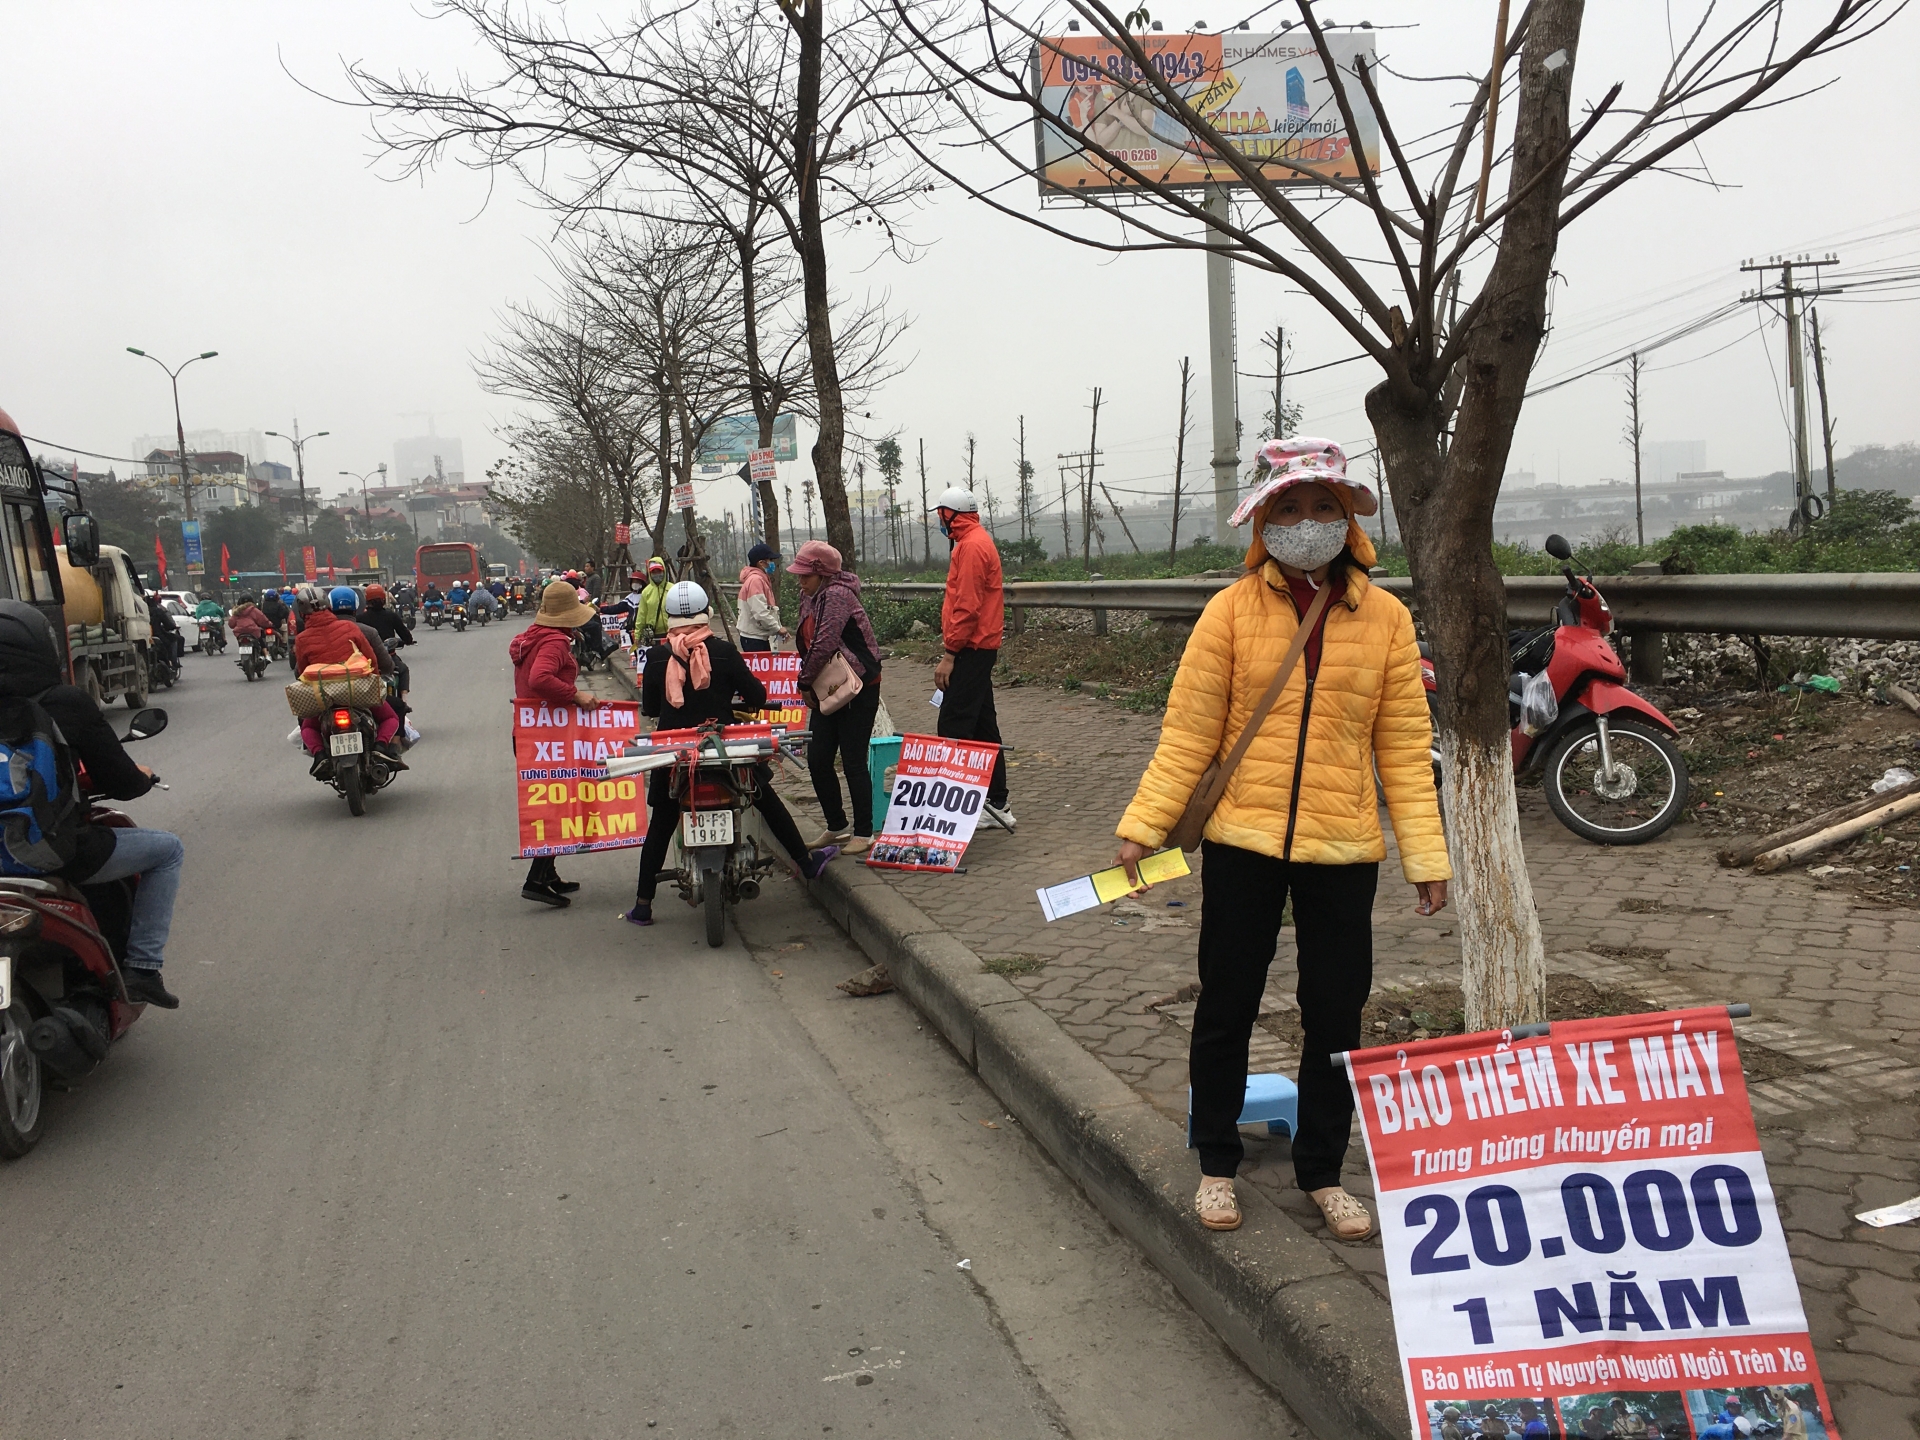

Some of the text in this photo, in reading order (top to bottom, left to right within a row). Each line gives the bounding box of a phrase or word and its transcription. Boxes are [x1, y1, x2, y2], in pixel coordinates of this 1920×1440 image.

[1062, 55, 1101, 82] 094
[1152, 52, 1204, 79] 0943
[1207, 106, 1271, 134] NHÀ
[1308, 118, 1337, 133] mới
[1131, 148, 1156, 161] 6268
[0, 463, 31, 489] SAMCO
[744, 654, 770, 671] BẢO
[769, 678, 798, 695] MÁY
[520, 701, 634, 728] BẢO HIỂM
[335, 743, 358, 755] 0168
[535, 737, 624, 762] XE MÁY
[903, 739, 993, 771] BẢO HIỂM XE MÁY
[521, 769, 547, 780] TƯNG
[550, 767, 577, 779] BỪNG
[965, 774, 981, 784] mại
[527, 780, 637, 806] 20.000
[893, 780, 981, 815] 20.000
[530, 811, 637, 841] 1 NĂM
[690, 828, 728, 843] 1982
[900, 813, 957, 836] 1 NĂM
[1369, 1020, 1725, 1134] BẢO HIỂM XE MÁY
[1411, 1116, 1714, 1177] Tưng bừng khuyến mại
[1404, 1164, 1762, 1275] 20.000
[1452, 1269, 1751, 1345] 1 NĂM
[1421, 1347, 1807, 1392] Bảo Hiểm Tự Nguyện Người Ngồi Trên Xe
